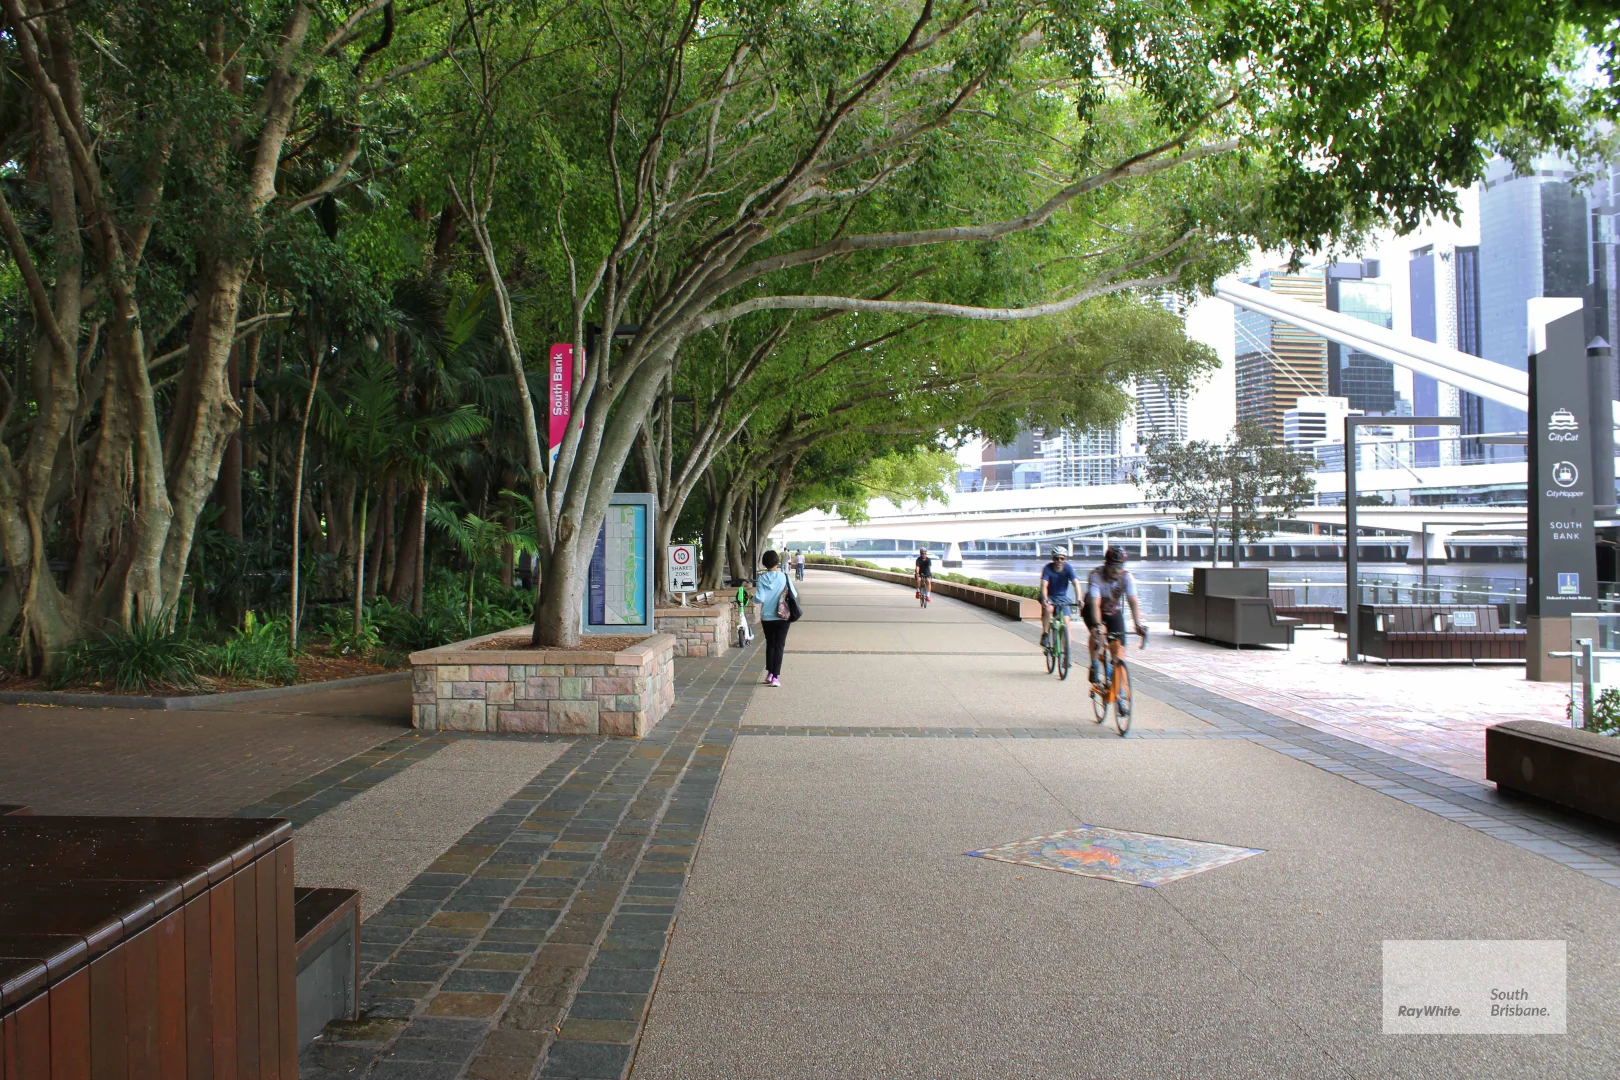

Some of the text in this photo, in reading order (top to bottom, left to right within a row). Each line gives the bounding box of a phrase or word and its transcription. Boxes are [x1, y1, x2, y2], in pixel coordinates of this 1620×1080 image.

[553, 353, 563, 416] South Bank
[1548, 432, 1579, 442] CityCat
[1546, 490, 1584, 498] CityHopper
[1550, 521, 1582, 529] SOUTH
[1553, 532, 1580, 540] BANK
[677, 552, 686, 560] 10
